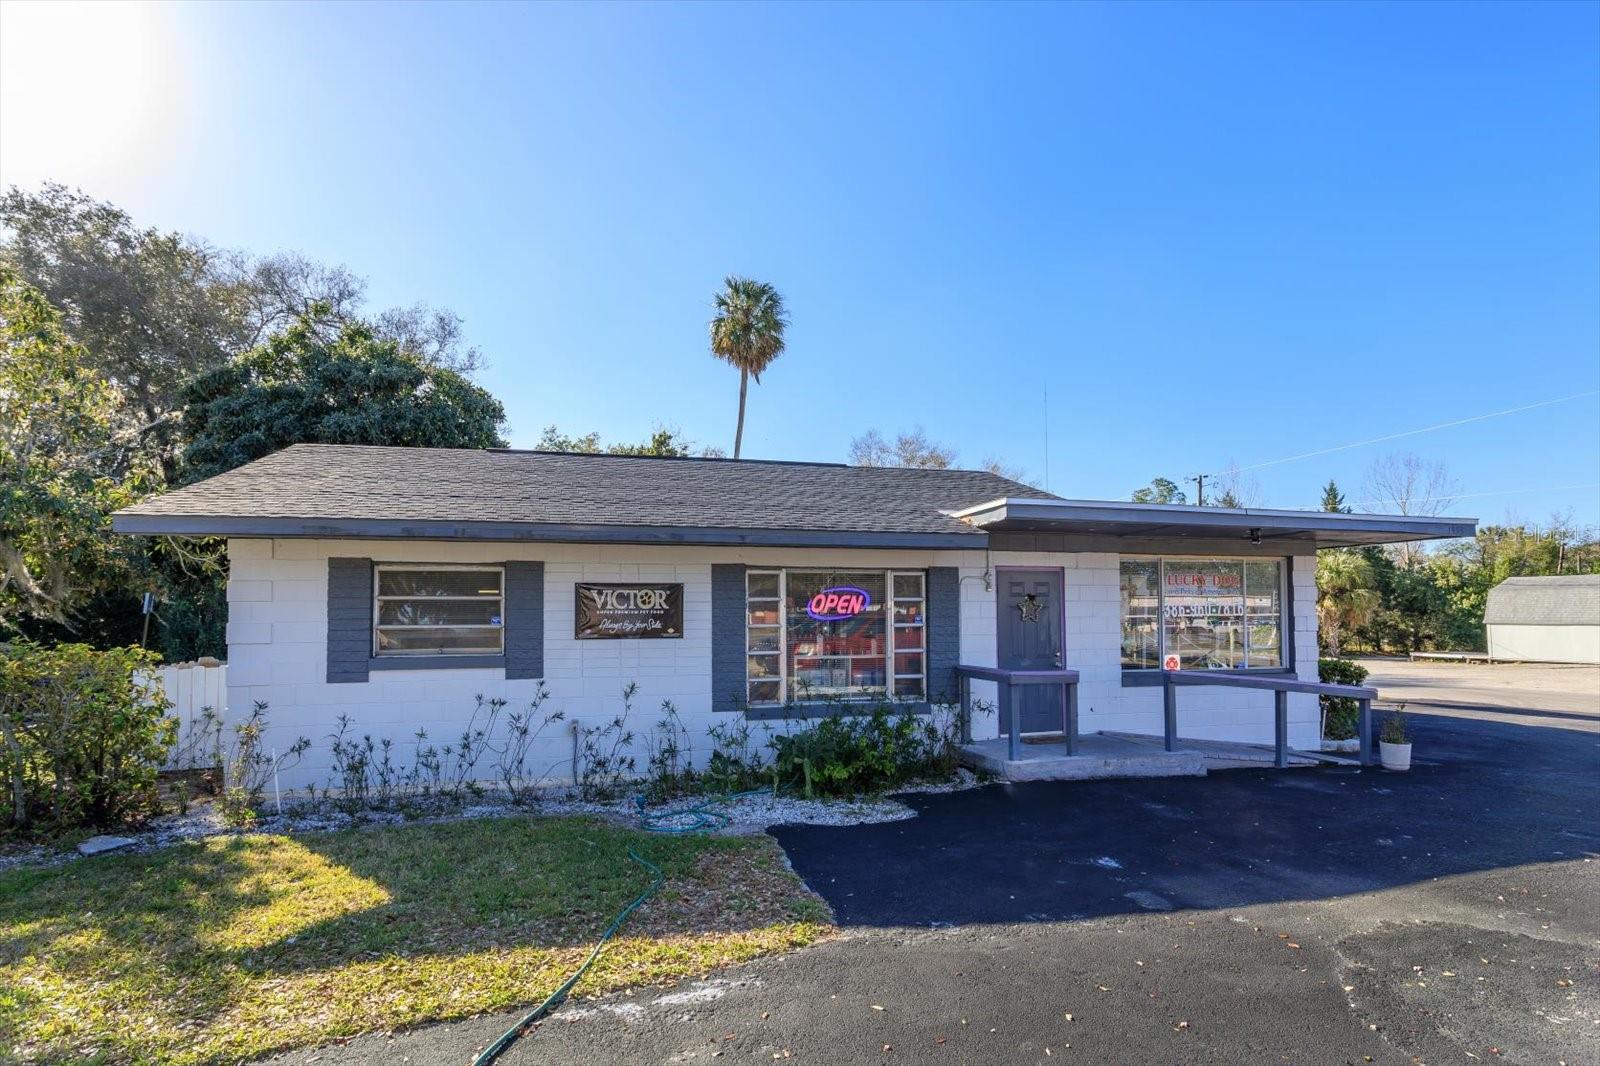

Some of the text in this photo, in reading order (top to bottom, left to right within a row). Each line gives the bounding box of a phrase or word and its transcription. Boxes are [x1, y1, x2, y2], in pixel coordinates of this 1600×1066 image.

[1168, 574, 1241, 586] LUCKY DOG
[590, 589, 669, 609] VICTOR
[811, 594, 865, 615] OPEN
